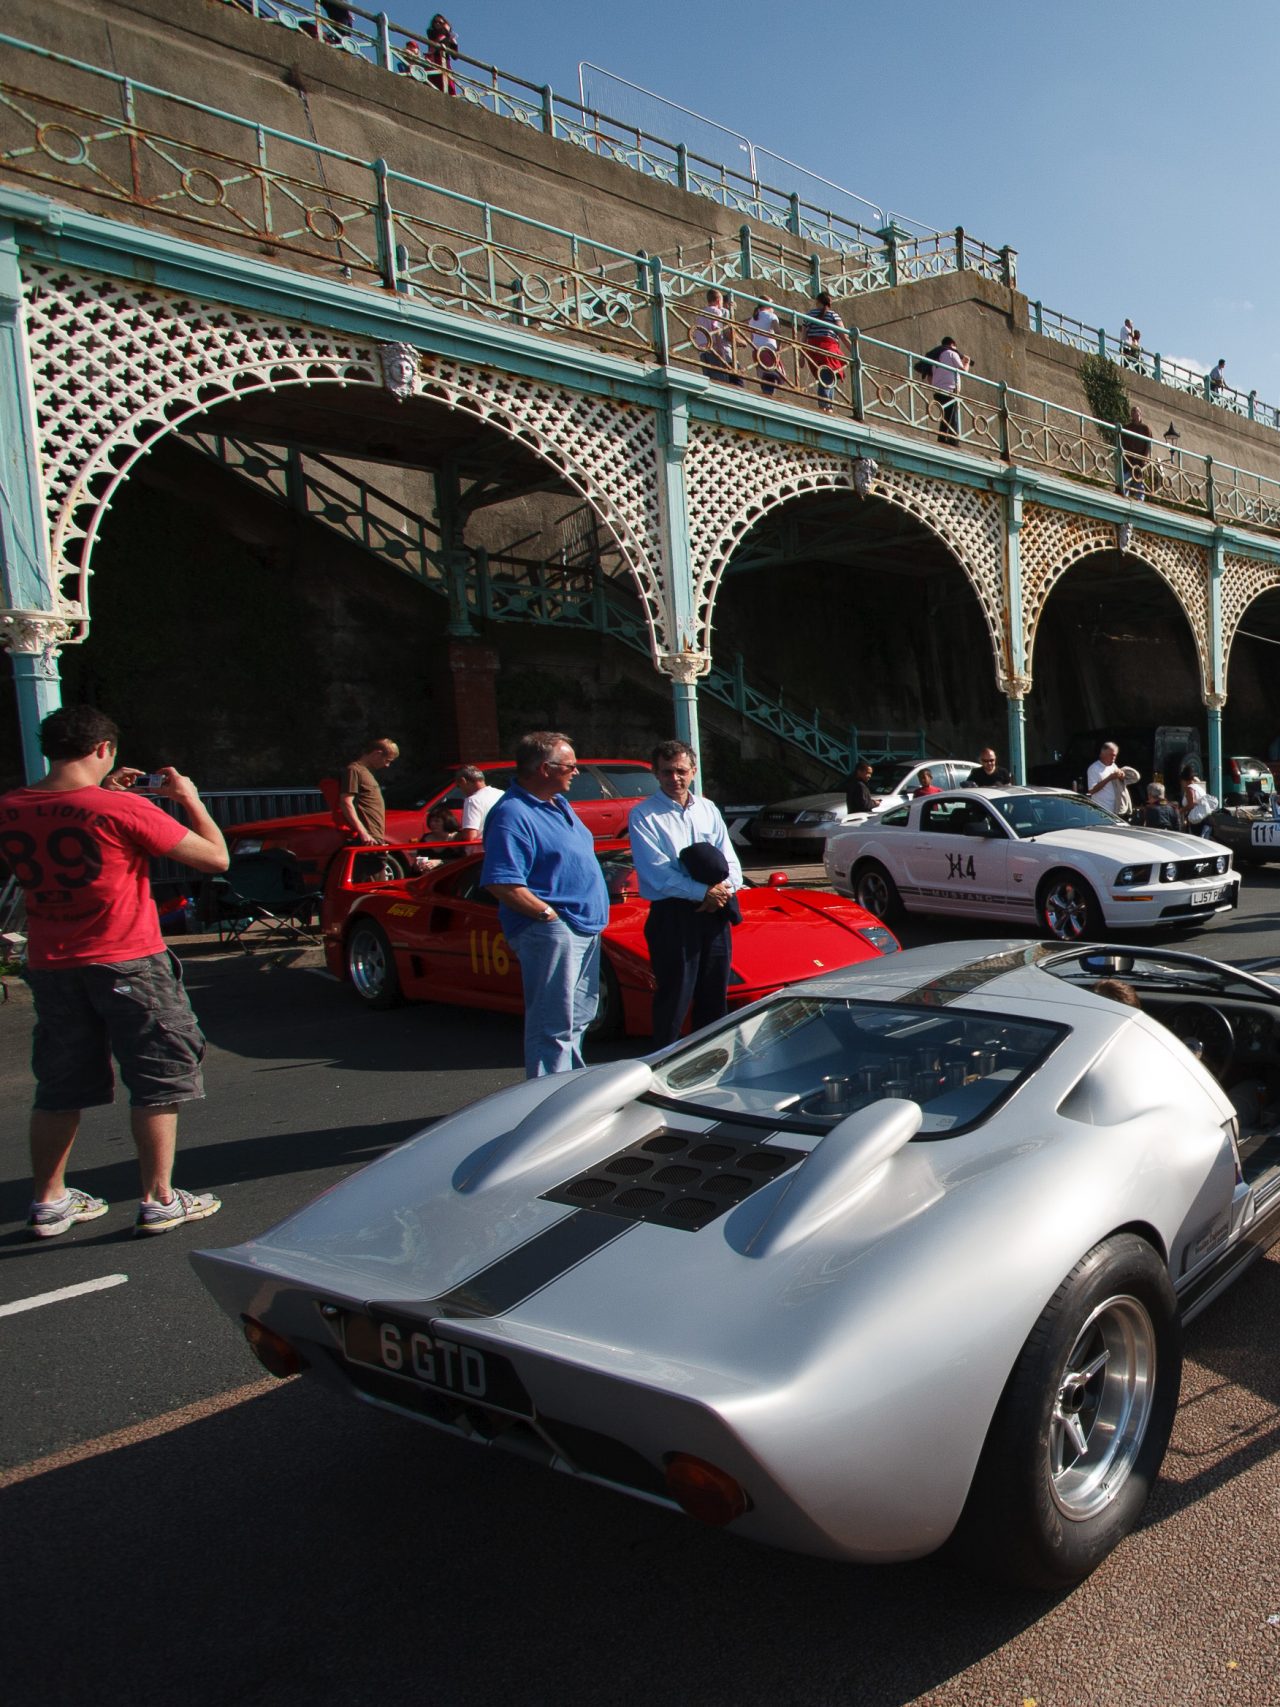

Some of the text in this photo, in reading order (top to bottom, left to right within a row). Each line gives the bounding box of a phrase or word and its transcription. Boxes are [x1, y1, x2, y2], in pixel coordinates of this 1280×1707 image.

[0, 826, 103, 889] 89
[931, 889, 994, 902] MUSTANG
[470, 929, 510, 976] 116
[380, 1322, 486, 1397] 6 GTD
